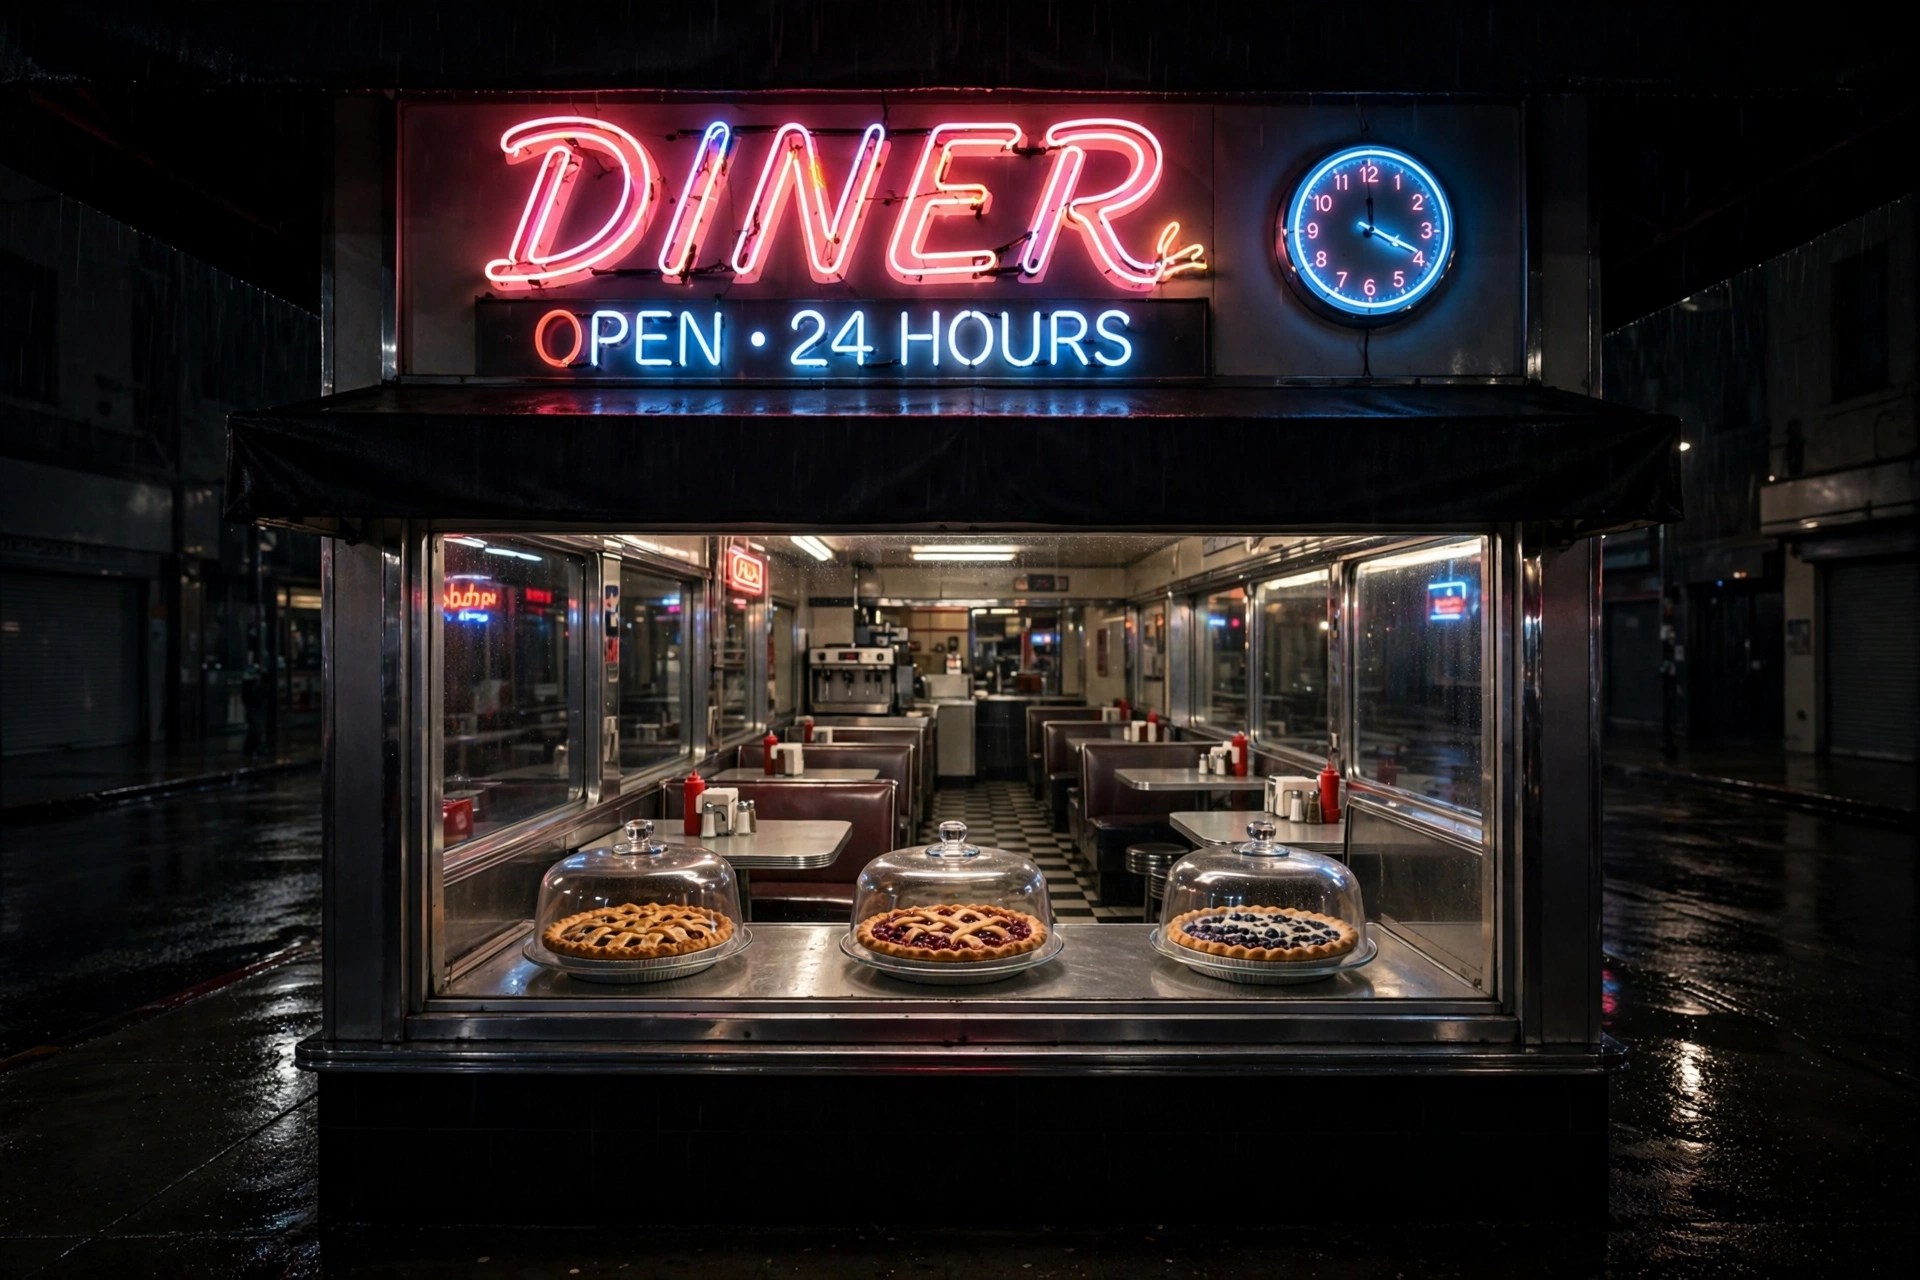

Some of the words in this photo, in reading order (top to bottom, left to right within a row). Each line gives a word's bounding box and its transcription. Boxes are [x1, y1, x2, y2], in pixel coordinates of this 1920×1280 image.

[1334, 174, 1348, 190] 11
[1359, 166, 1379, 183] 12
[1394, 174, 1401, 190] 1
[484, 117, 1166, 289] DINER
[1314, 194, 1332, 212] 10
[1412, 193, 1424, 211] 2
[1307, 222, 1319, 239] 9
[1421, 222, 1433, 239] 3
[1315, 250, 1327, 268] 8
[1412, 250, 1425, 267] 4
[1336, 271, 1348, 288] 7
[1363, 278, 1376, 296] 6
[1393, 271, 1404, 288] 5
[534, 309, 722, 367] OPEN
[790, 309, 874, 366] 24
[900, 309, 1132, 367] HOURS
